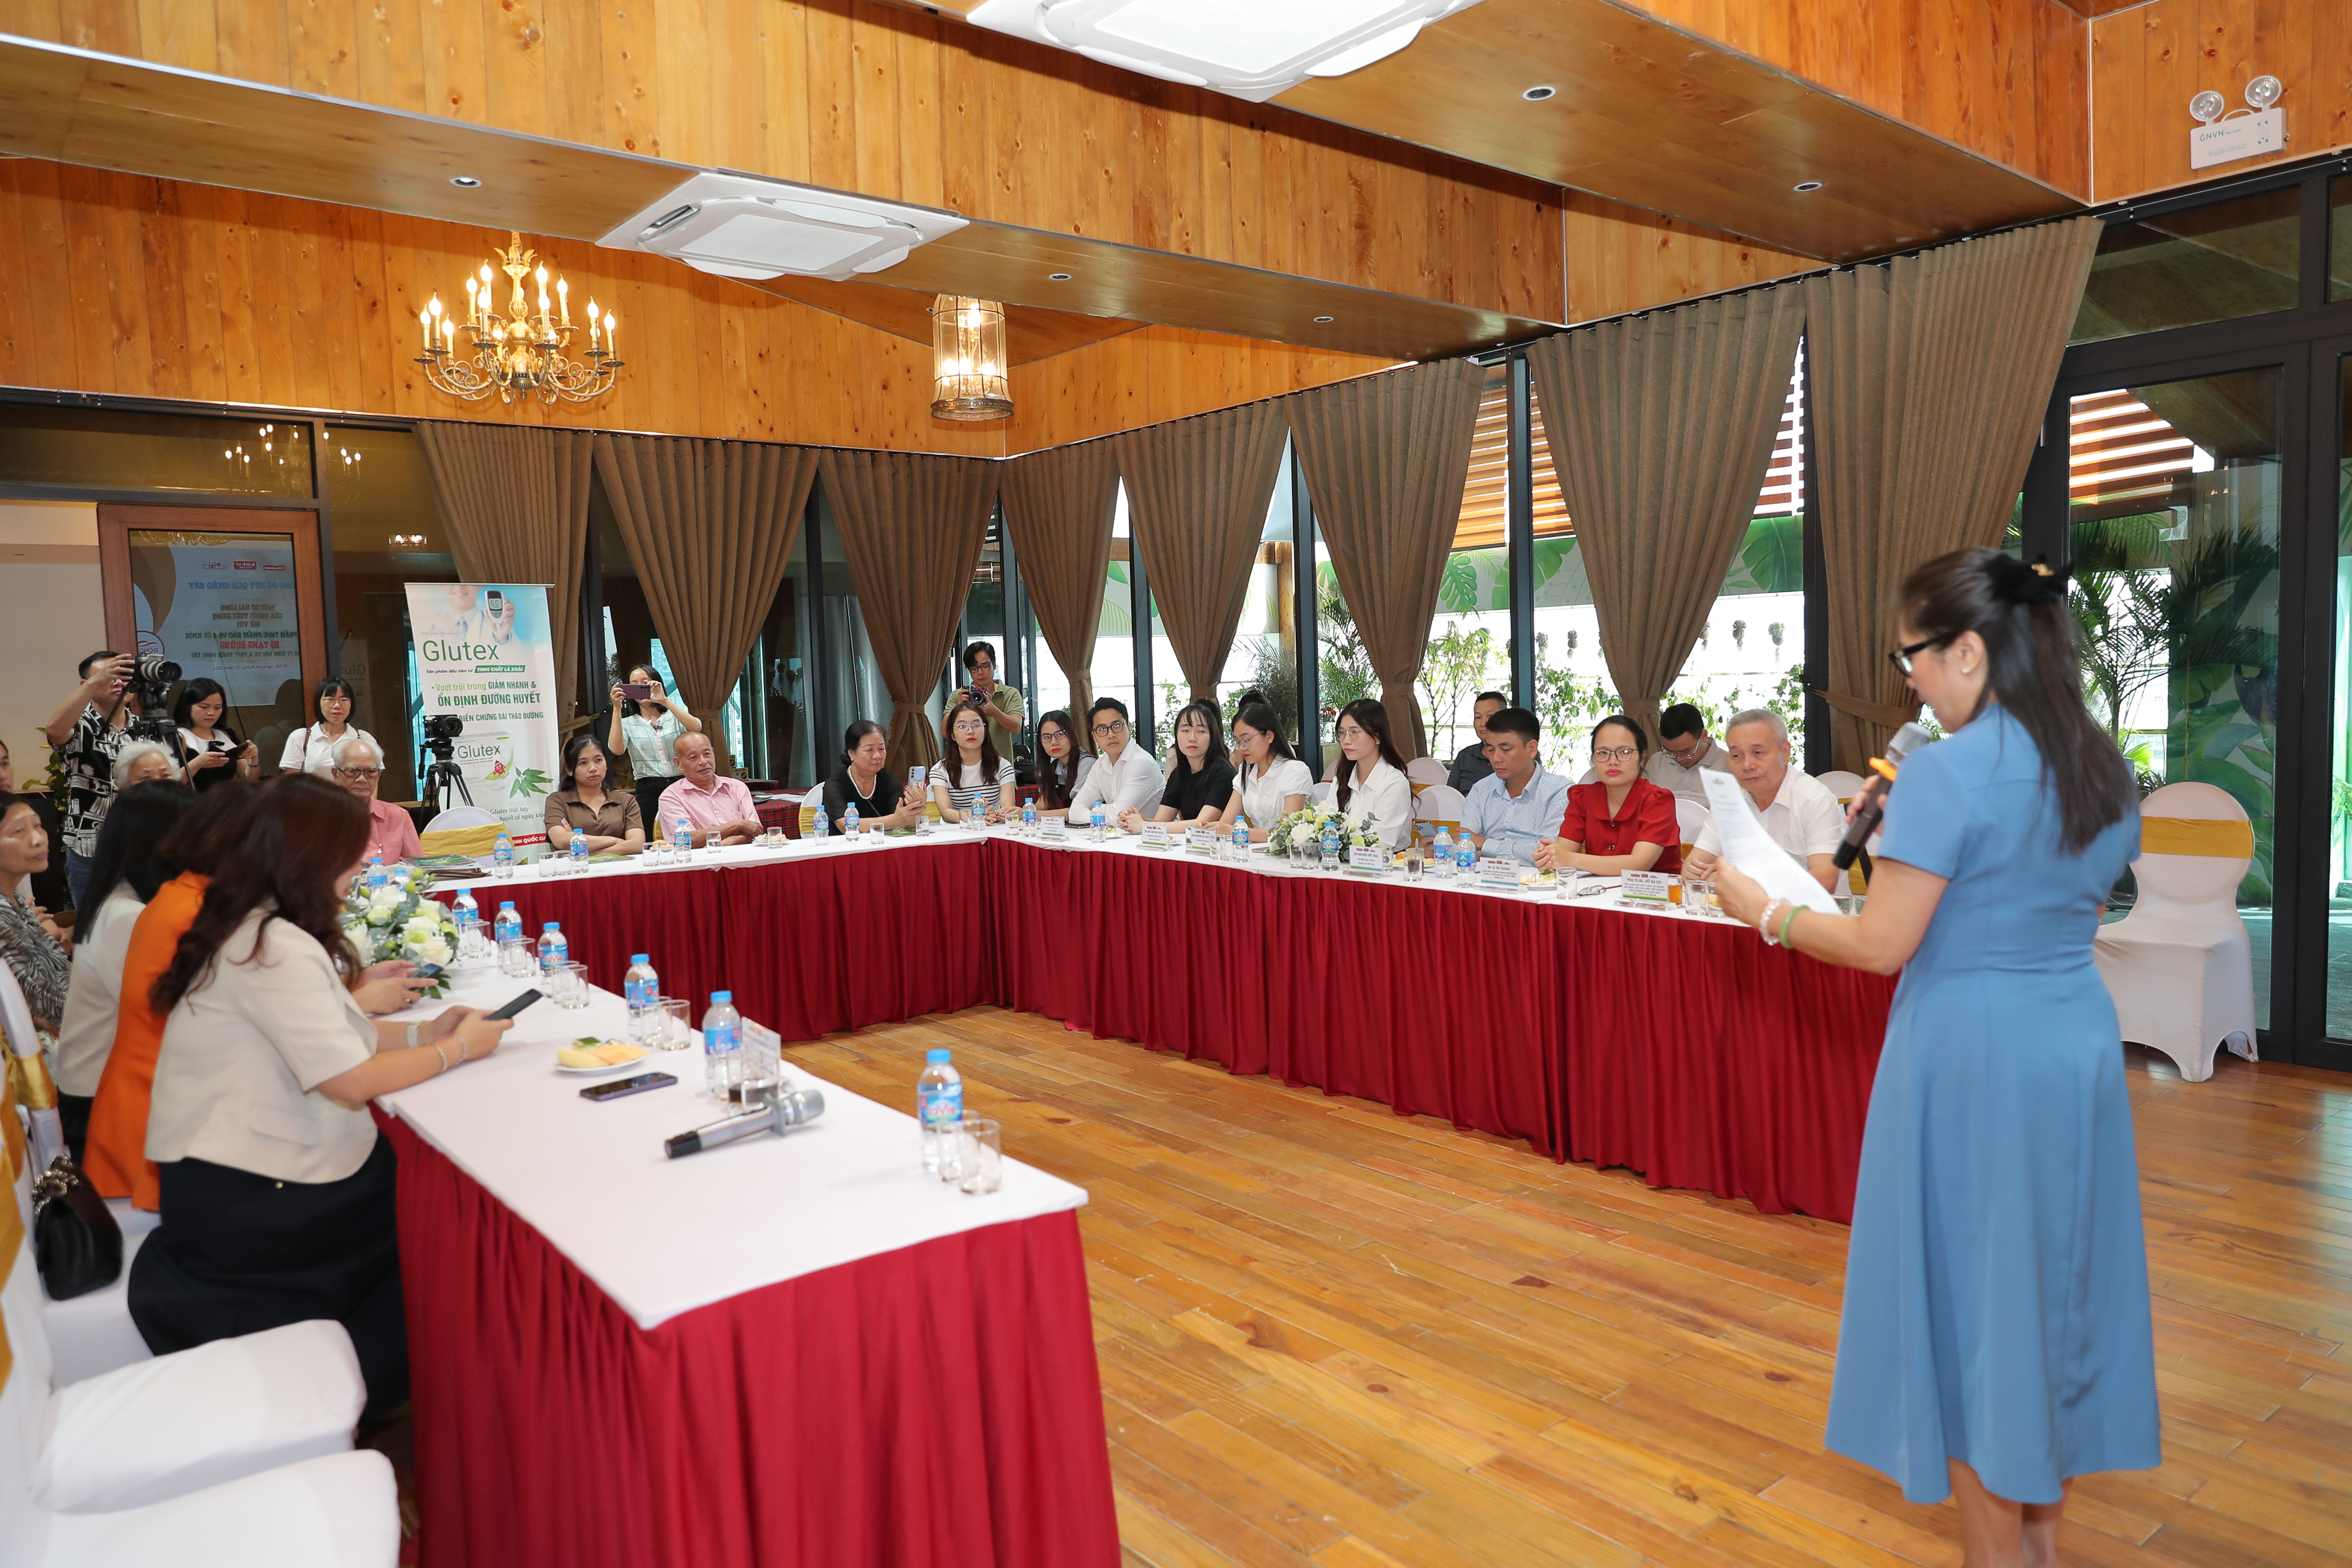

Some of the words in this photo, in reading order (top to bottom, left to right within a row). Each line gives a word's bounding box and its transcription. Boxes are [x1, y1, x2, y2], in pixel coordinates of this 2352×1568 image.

[2199, 129, 2223, 142] GNVN
[423, 639, 500, 662] Glutex
[435, 683, 451, 692] Vượt
[453, 683, 465, 692] trội
[488, 679, 505, 689] GIẢM
[438, 692, 451, 707] ỔN
[454, 695, 478, 708] ĐỊNH
[481, 692, 511, 704] ĐƯỜNG
[514, 690, 541, 704] HUYẾT
[459, 713, 474, 722] BIẾN
[476, 712, 497, 721] CHỨNG
[523, 711, 544, 719] ĐƯỜNG
[457, 744, 502, 759] Glutex
